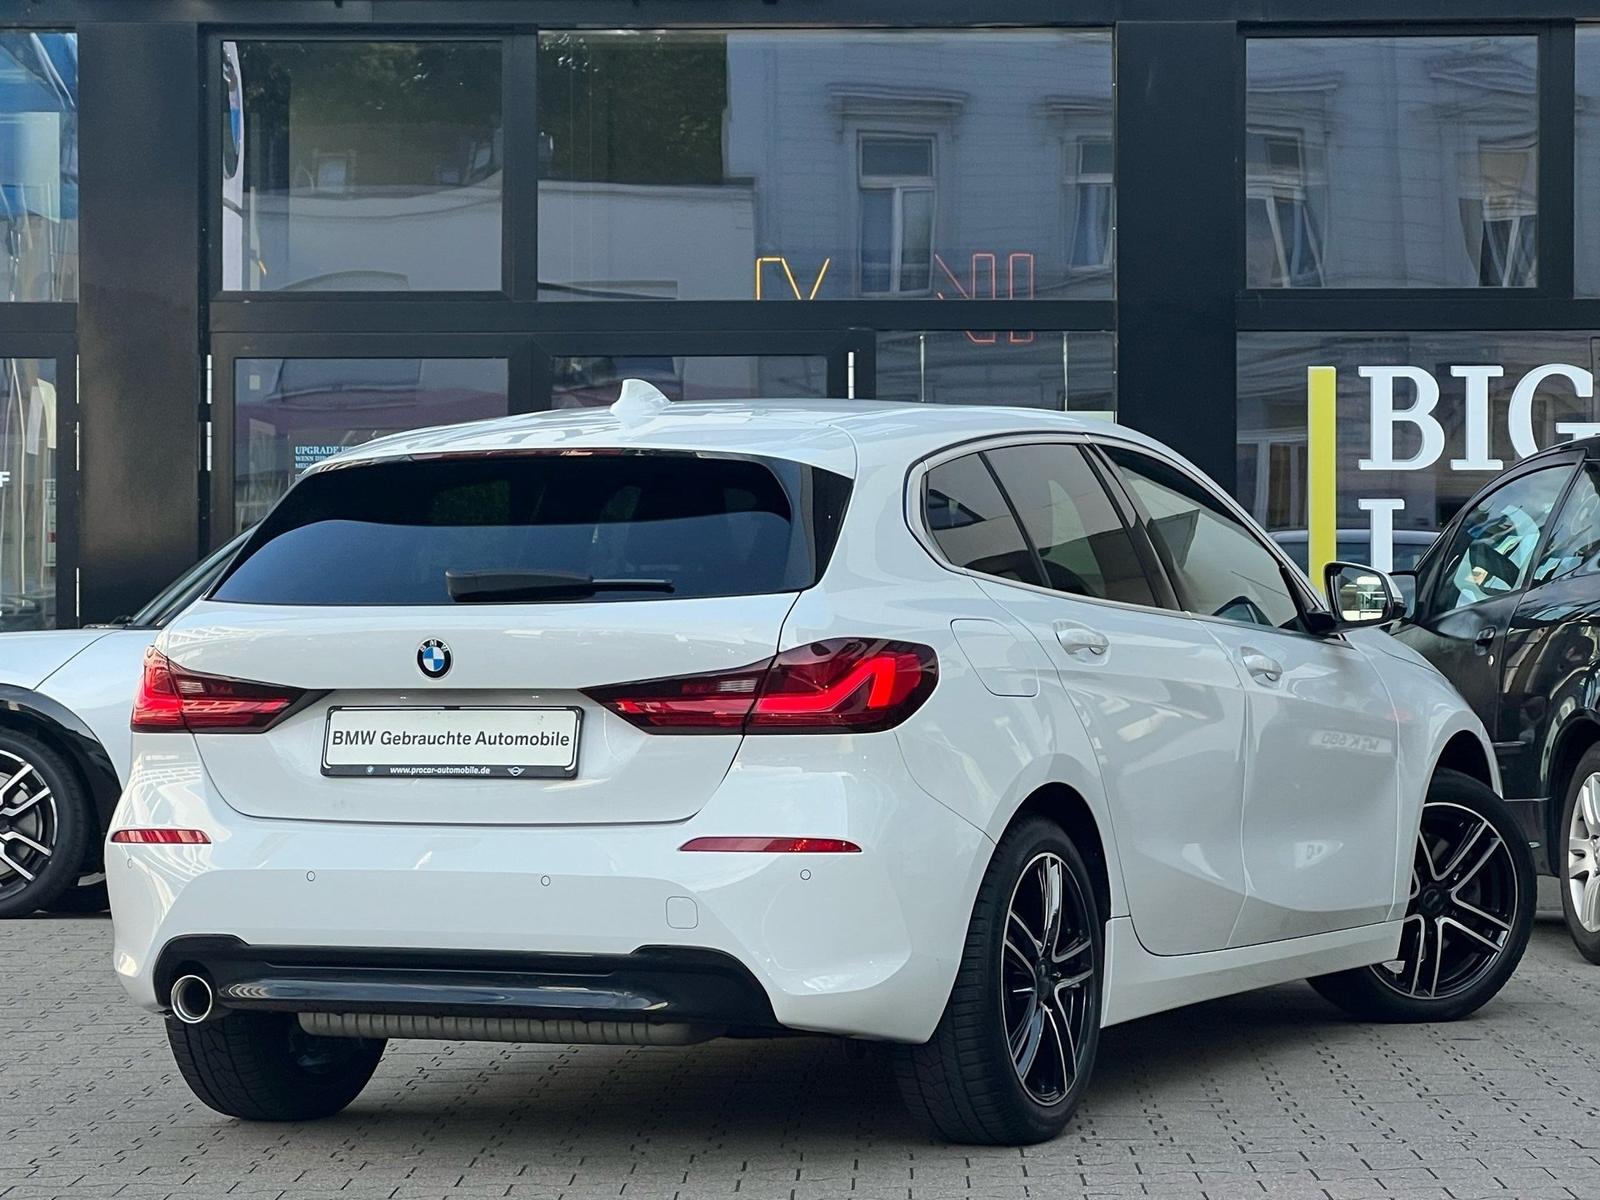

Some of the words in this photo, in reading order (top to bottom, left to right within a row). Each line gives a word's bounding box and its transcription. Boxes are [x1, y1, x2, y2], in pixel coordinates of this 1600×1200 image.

[1357, 363, 1600, 471] BIG
[332, 730, 376, 746] BMW
[380, 729, 472, 746] Gebrauchte
[474, 730, 570, 747] Automobile
[389, 765, 491, 775] www.procar-automobile.de
